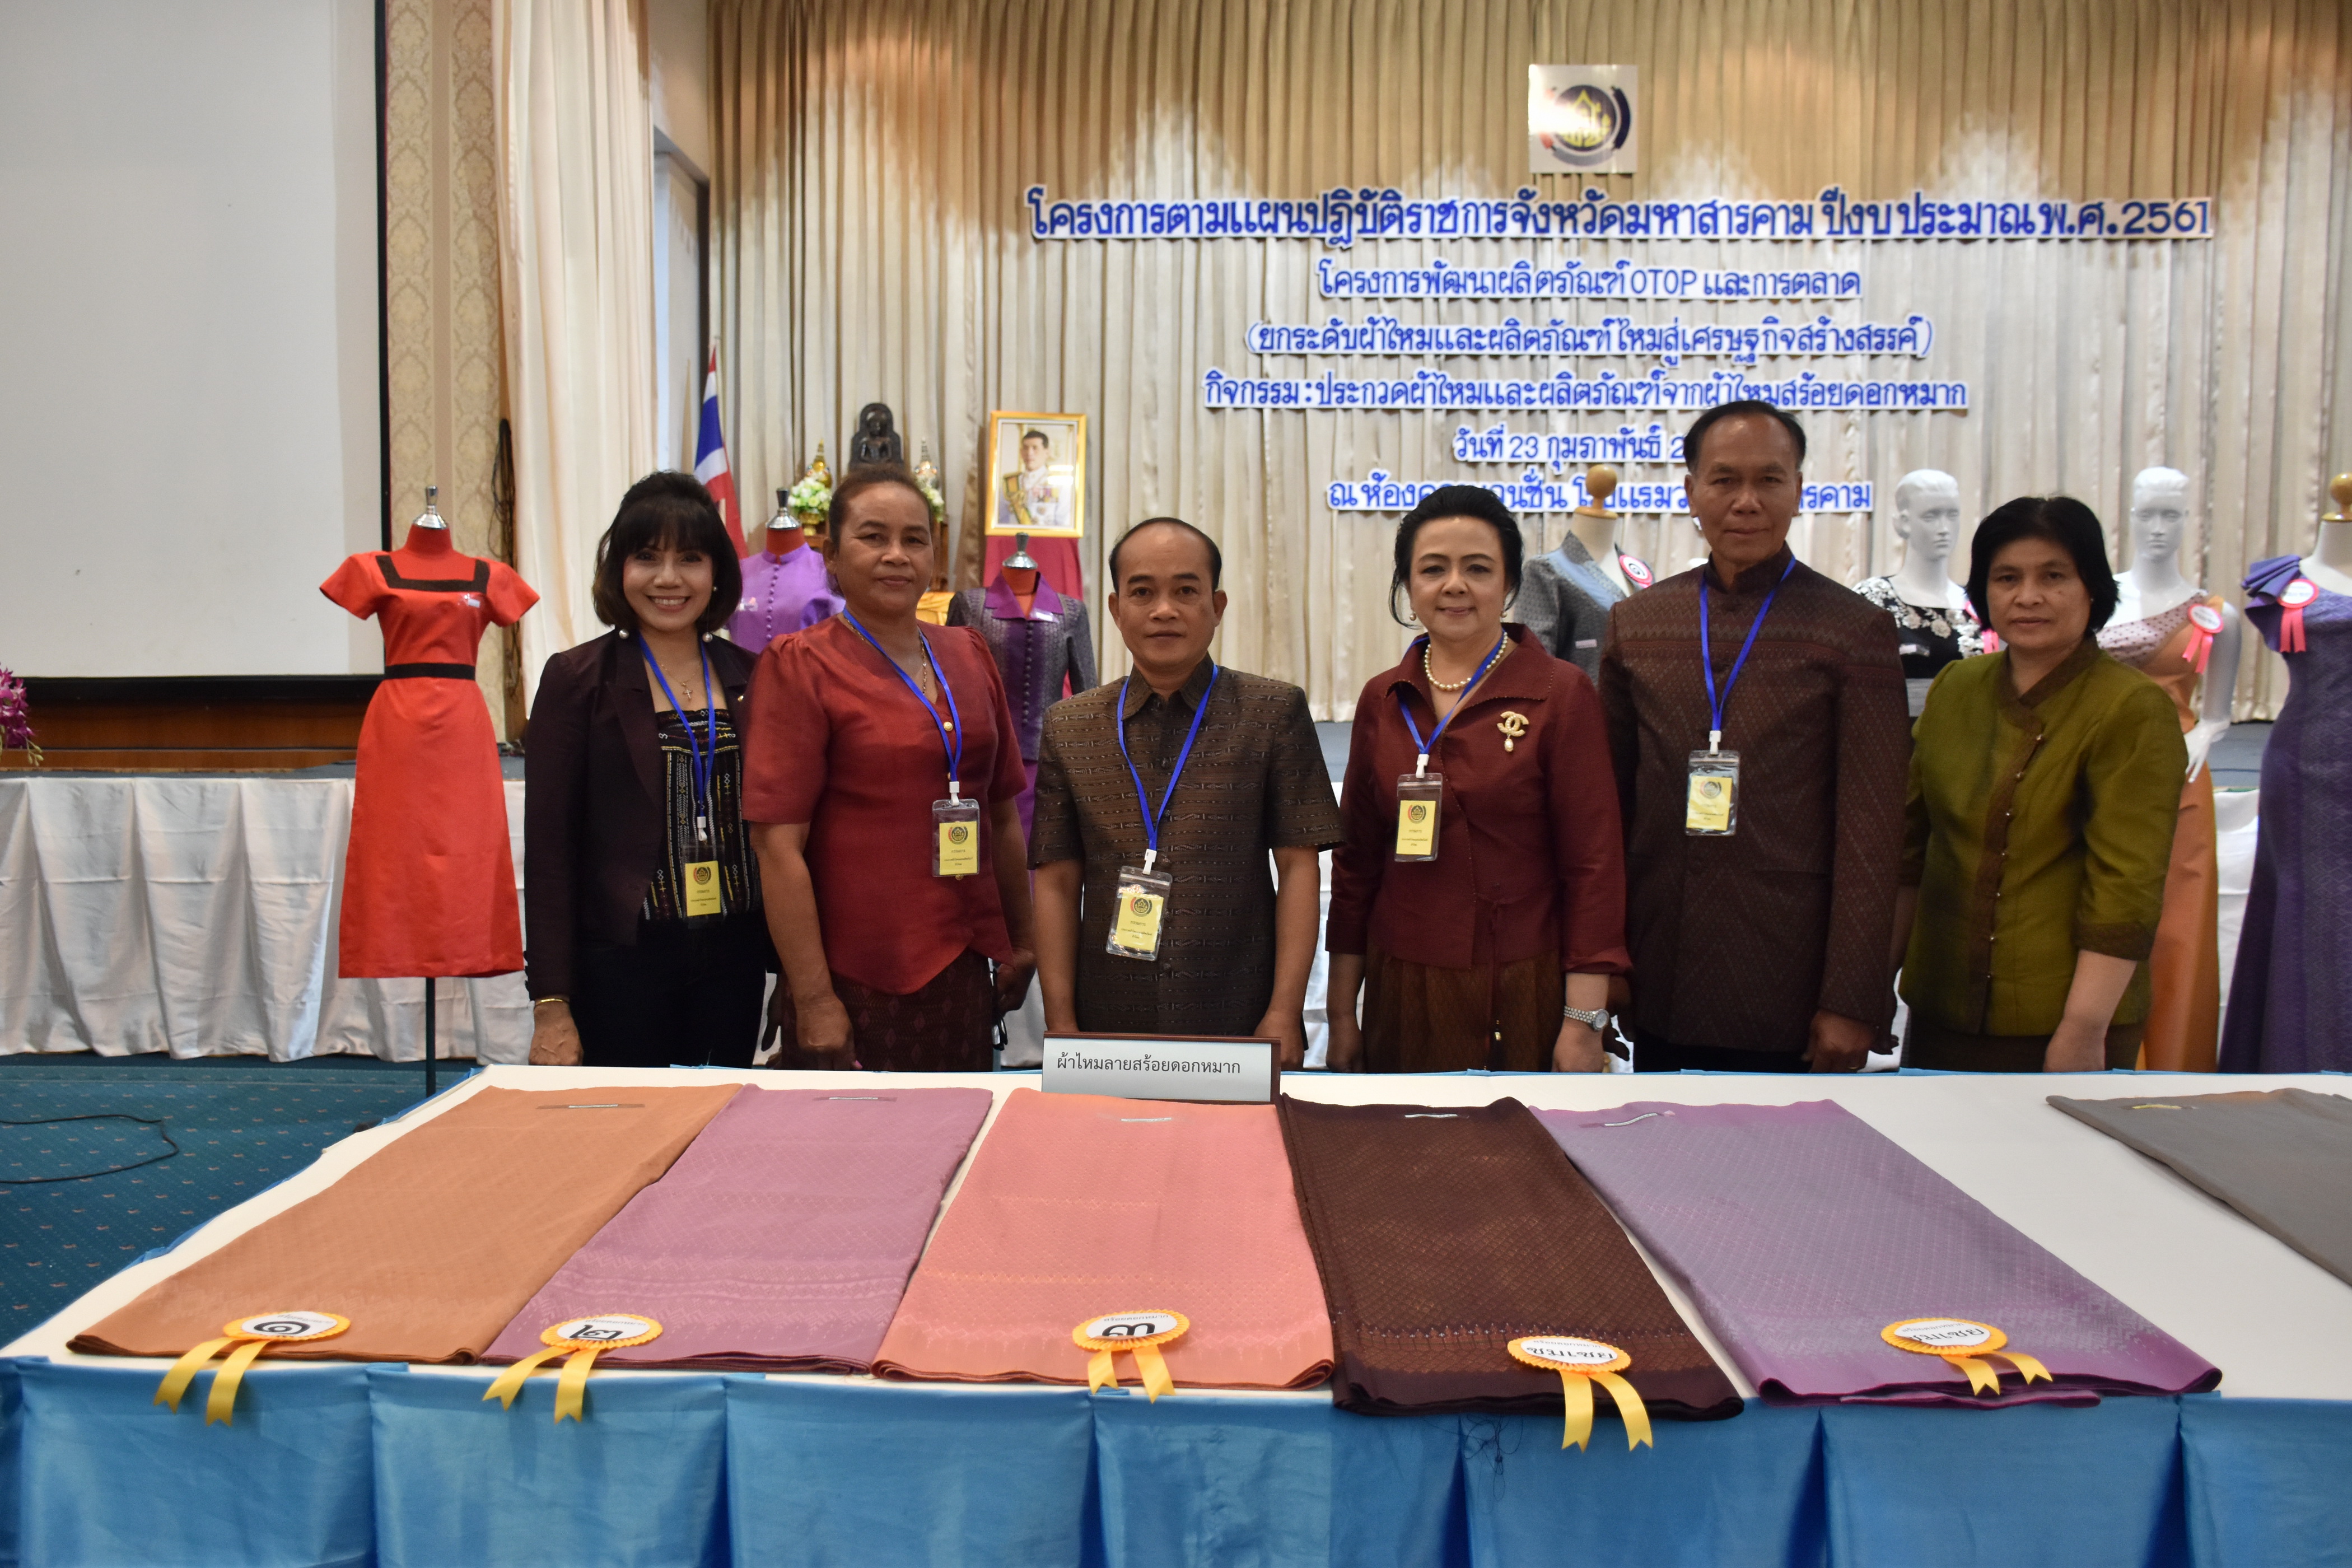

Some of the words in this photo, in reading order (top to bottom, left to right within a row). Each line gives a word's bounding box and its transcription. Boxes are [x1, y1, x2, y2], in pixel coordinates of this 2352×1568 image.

[1456, 423, 1504, 458] วันที่
[1509, 436, 1538, 458] 23
[1057, 1052, 1241, 1074] ผ้าไหมลายสร้อยดอกหมาก
[1527, 1347, 1614, 1360] ชมเชย
